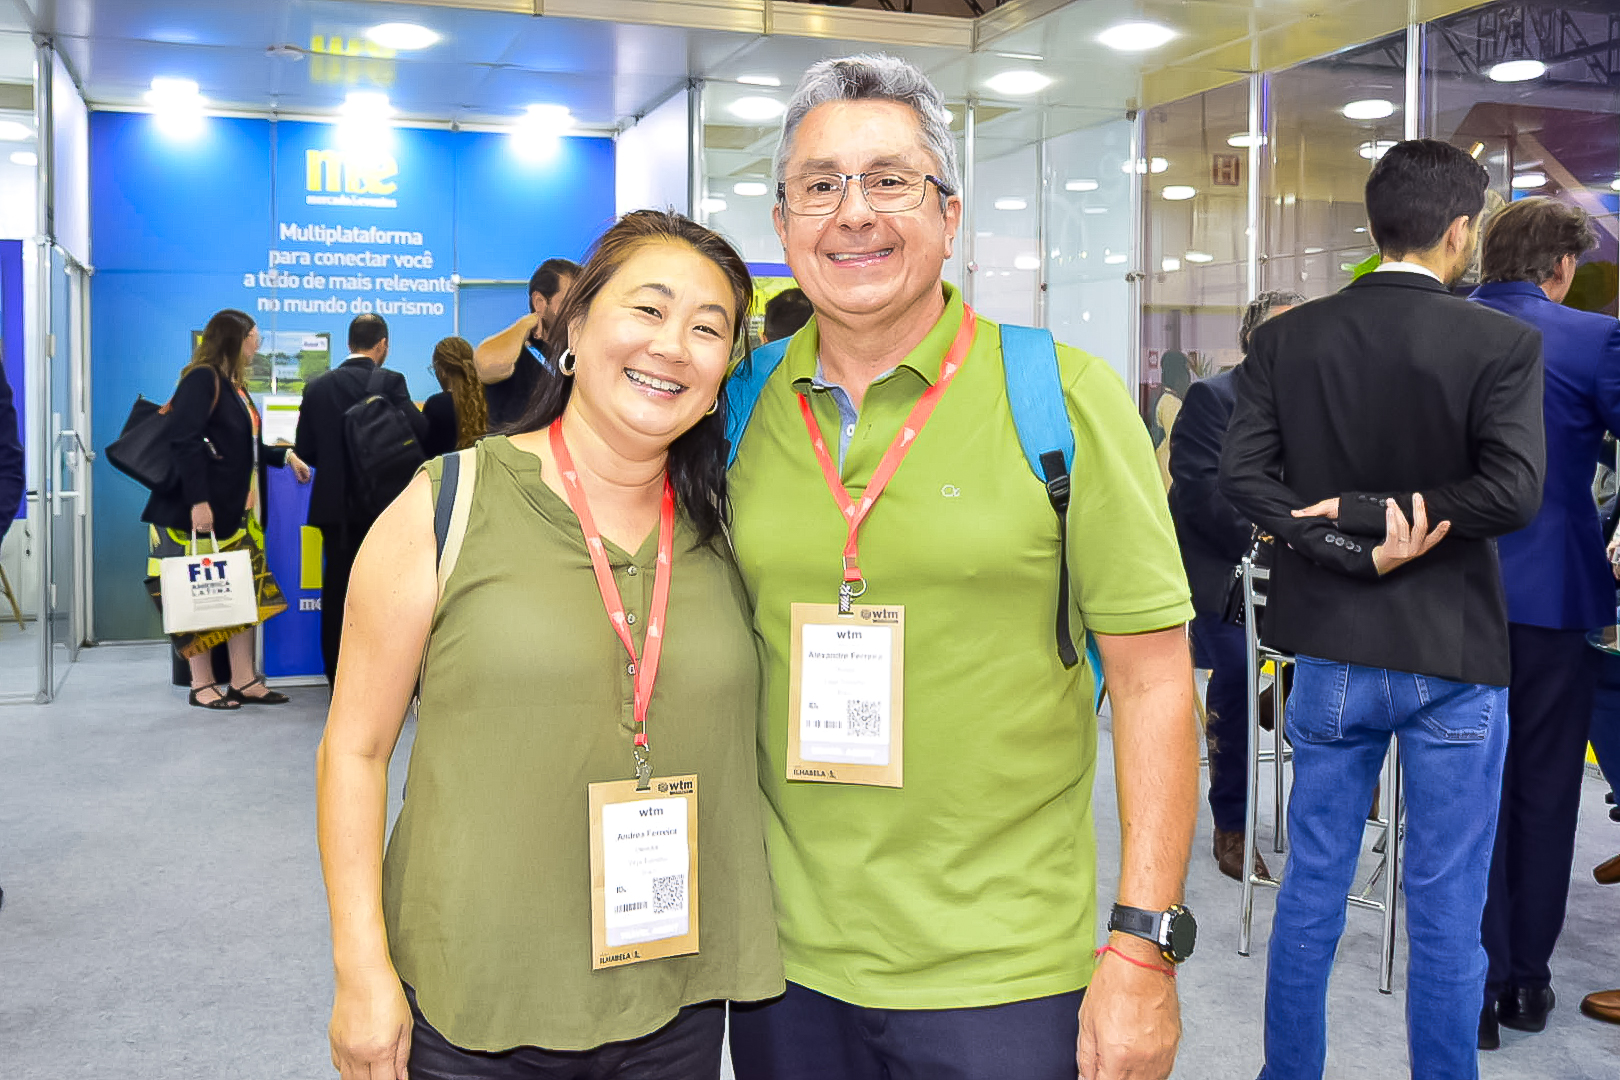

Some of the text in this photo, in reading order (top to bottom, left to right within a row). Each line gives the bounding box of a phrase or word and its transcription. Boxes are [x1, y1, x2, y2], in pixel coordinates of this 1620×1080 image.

[279, 223, 423, 247] Multiplataforma
[269, 250, 434, 269] para conectar você
[243, 273, 256, 288] a
[302, 271, 326, 289] de
[329, 273, 372, 291] mais
[376, 274, 458, 293] relevante
[257, 296, 444, 316] no mundo do turismo
[872, 608, 898, 619] wtm
[836, 629, 863, 640] wtm
[669, 779, 693, 791] wtm
[638, 806, 665, 818] wtm
